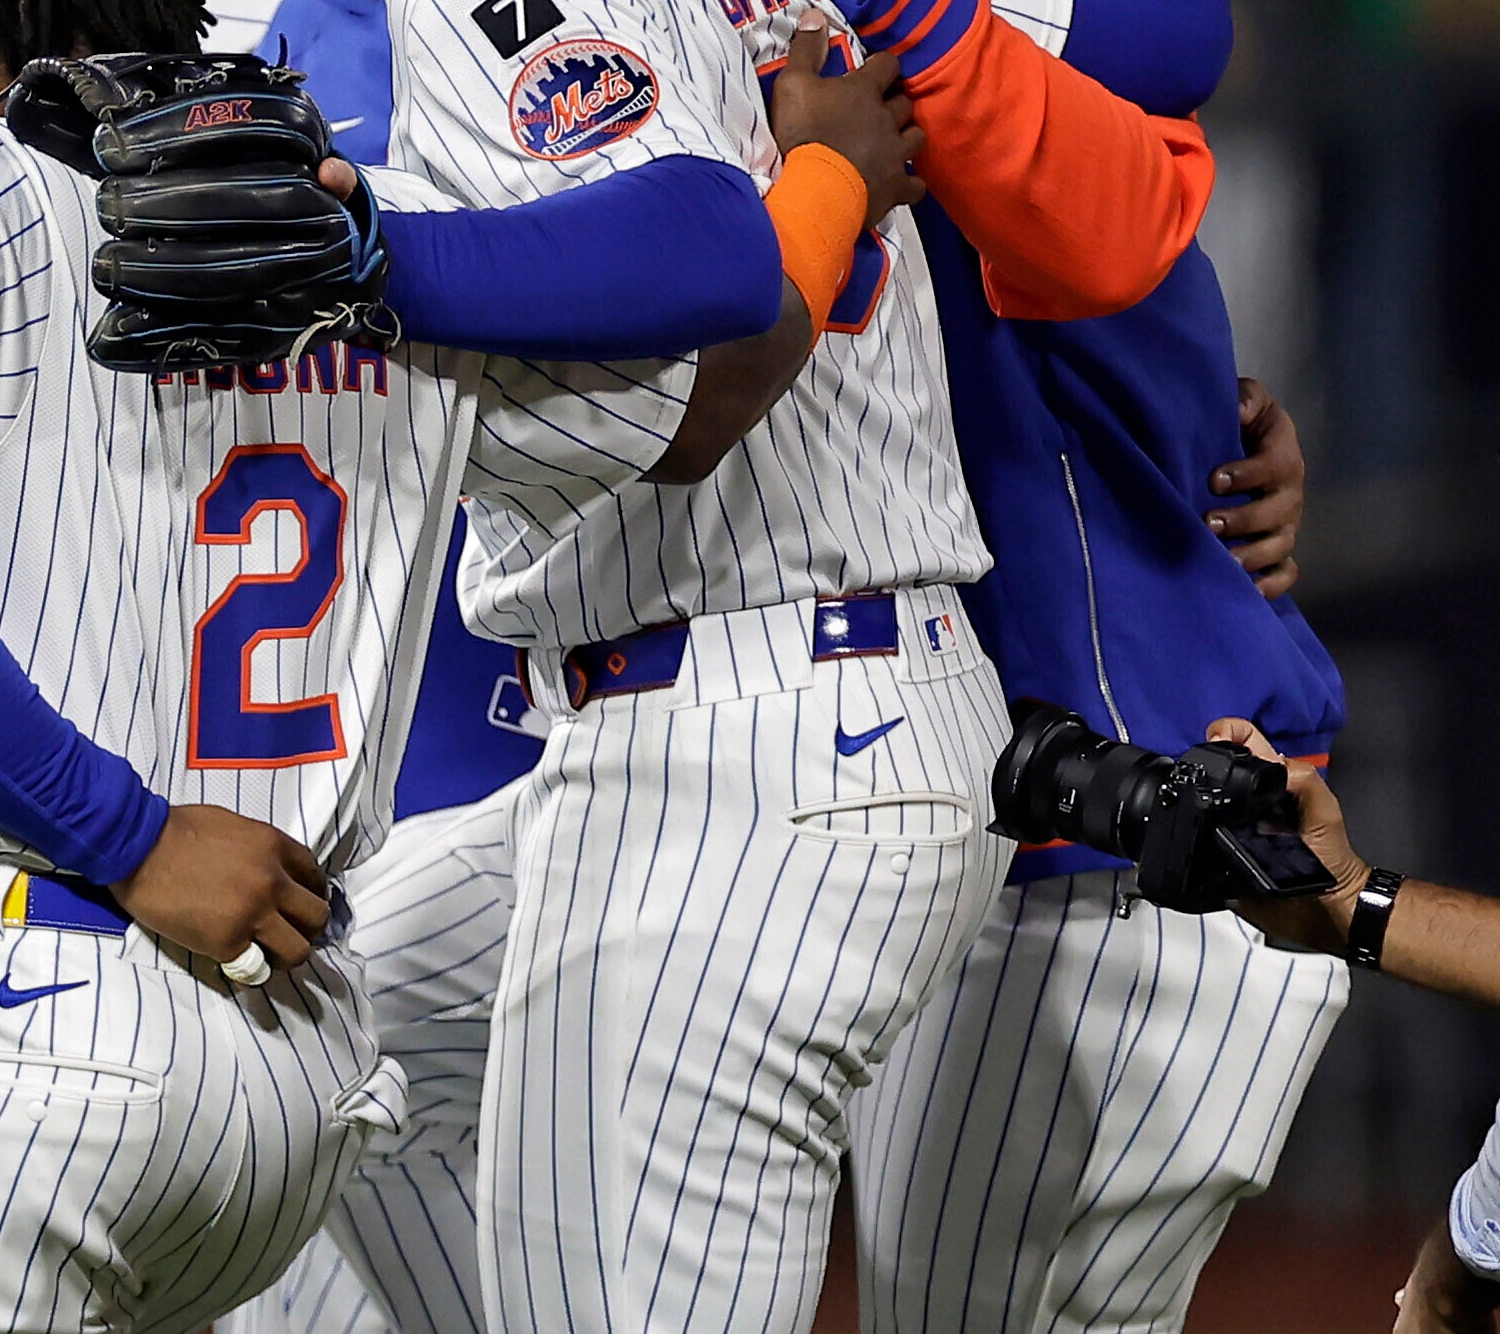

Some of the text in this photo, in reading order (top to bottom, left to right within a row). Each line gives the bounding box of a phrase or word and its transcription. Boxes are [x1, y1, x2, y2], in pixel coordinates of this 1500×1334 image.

[183, 100, 252, 132] A2K
[545, 68, 634, 144] Mets
[187, 442, 348, 770] 2
